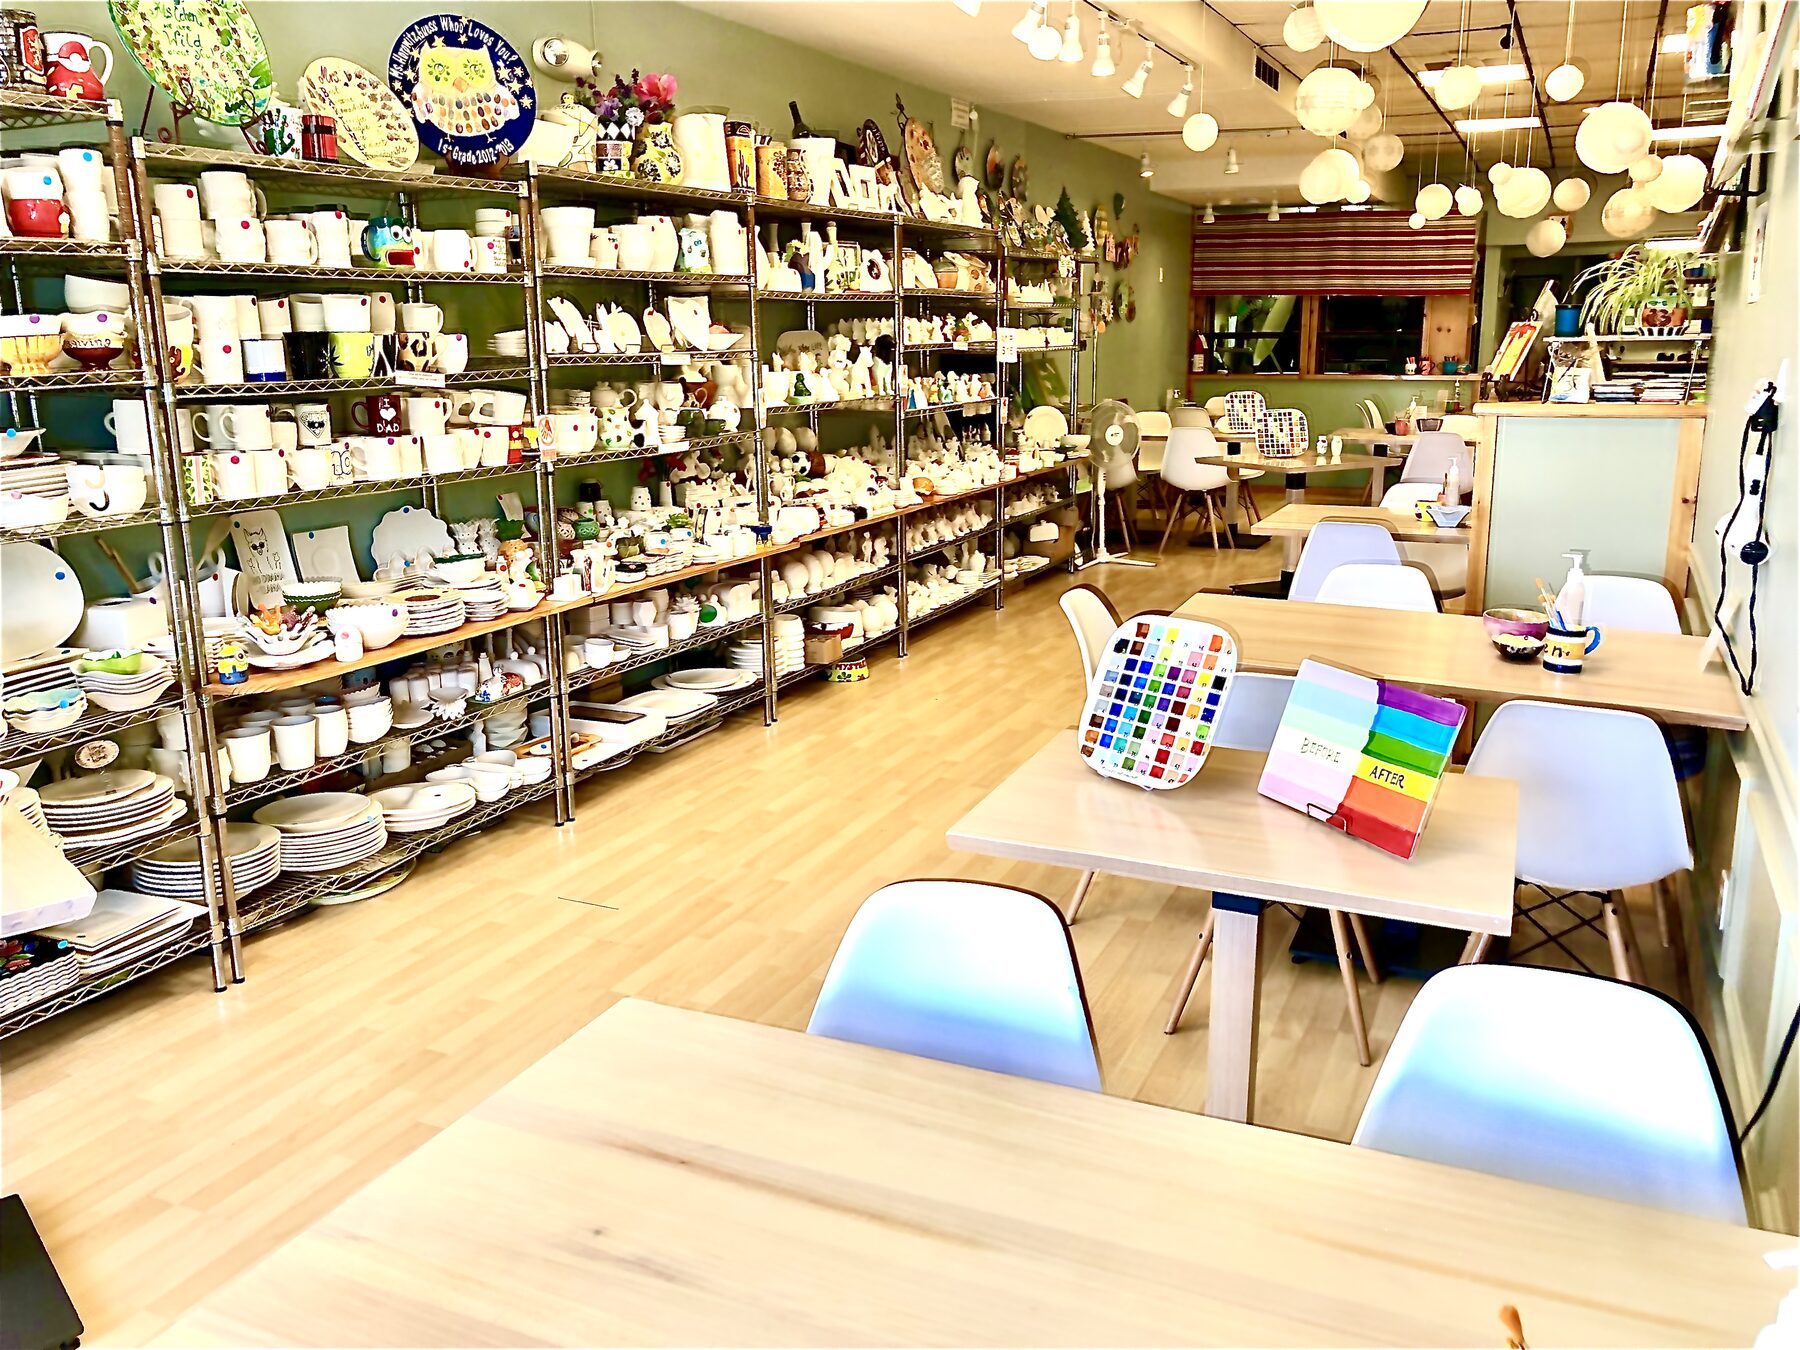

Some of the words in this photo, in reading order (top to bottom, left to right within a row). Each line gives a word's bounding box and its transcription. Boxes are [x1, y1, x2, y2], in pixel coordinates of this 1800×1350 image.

[163, 30, 201, 47] Wild
[440, 16, 465, 34] Whoo
[468, 22, 495, 46] Loves
[495, 39, 519, 65] You?
[452, 147, 477, 165] Grade
[1299, 736, 1342, 763] BEFORE
[1369, 765, 1405, 789] AFTER
